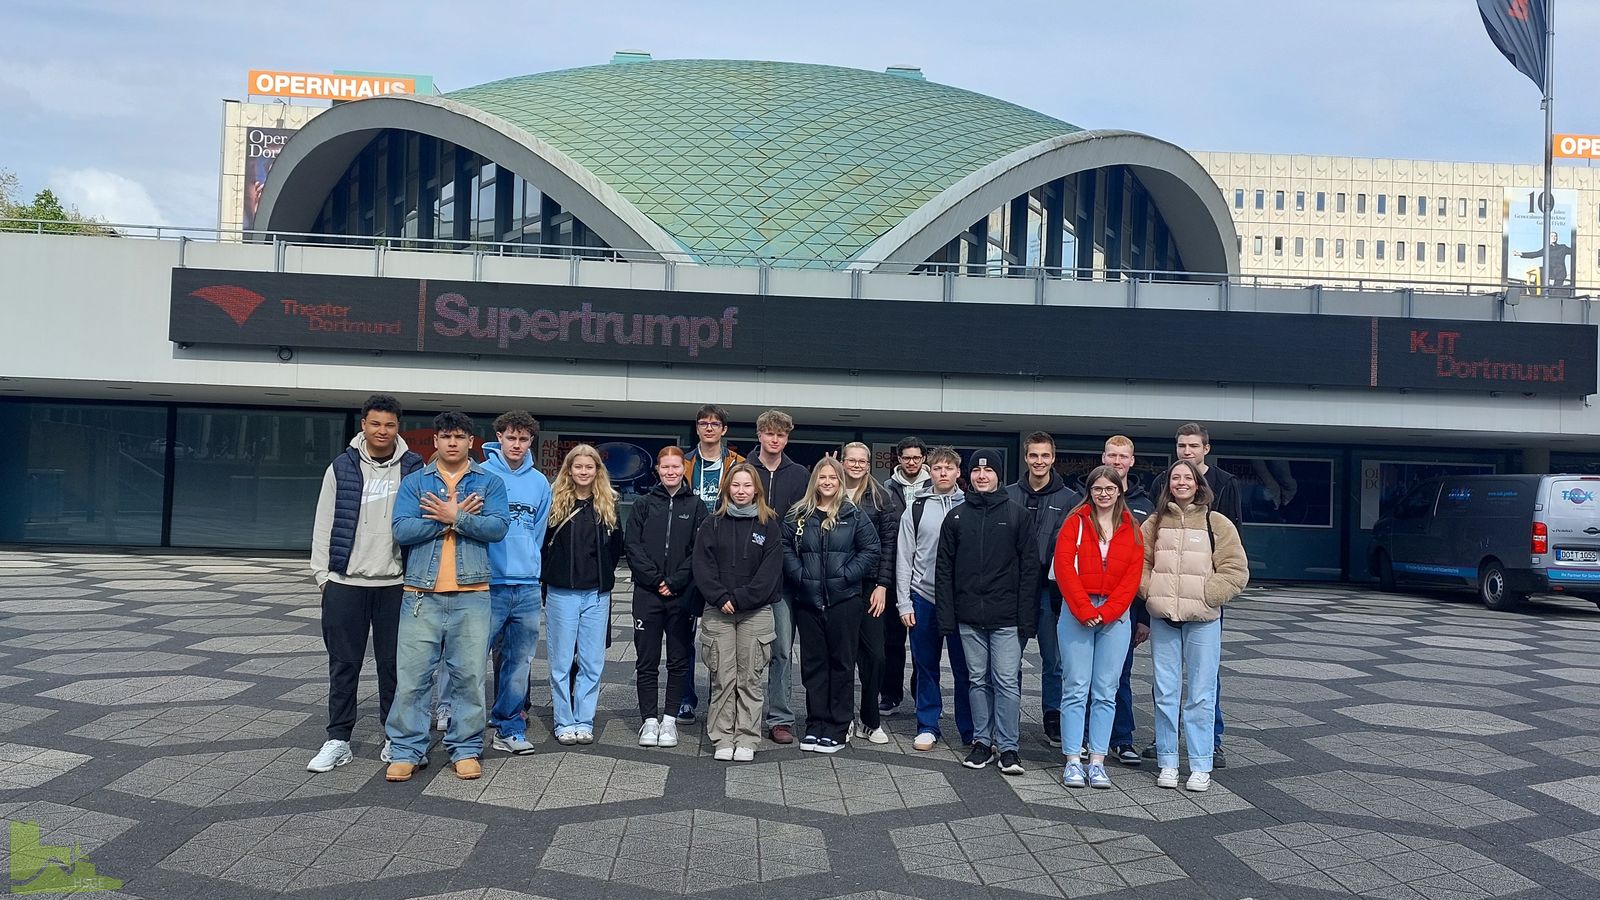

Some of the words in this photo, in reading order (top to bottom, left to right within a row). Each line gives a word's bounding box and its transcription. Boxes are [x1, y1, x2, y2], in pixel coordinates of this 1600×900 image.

[256, 74, 406, 97] OPERNHAUS
[249, 130, 288, 148] Oper
[280, 299, 352, 316] Theater
[308, 315, 401, 335] Dortmund
[433, 292, 739, 357] Supertrumpf
[1410, 330, 1462, 354] KJT
[1436, 354, 1566, 382] Dortmund
